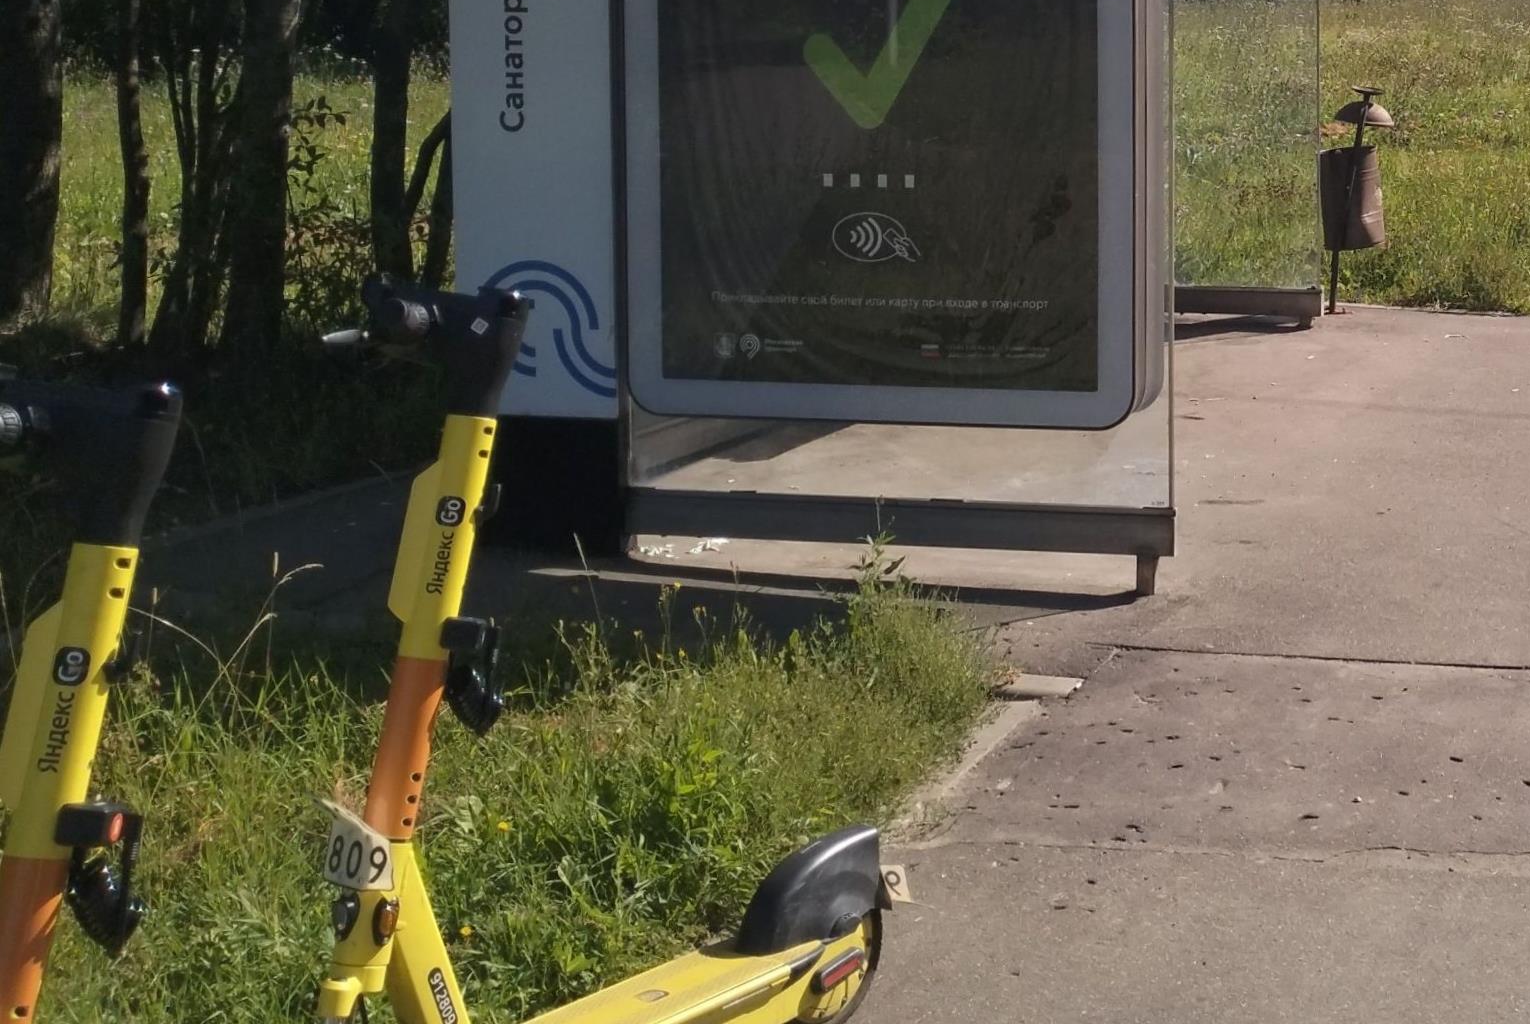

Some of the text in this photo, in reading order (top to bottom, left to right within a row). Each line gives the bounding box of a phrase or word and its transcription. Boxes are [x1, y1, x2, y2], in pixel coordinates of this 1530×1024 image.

[426, 500, 461, 595] Яндекс Go
[37, 651, 83, 773] Яндекс Go
[328, 834, 388, 884] 809
[430, 972, 456, 1024] 912809
